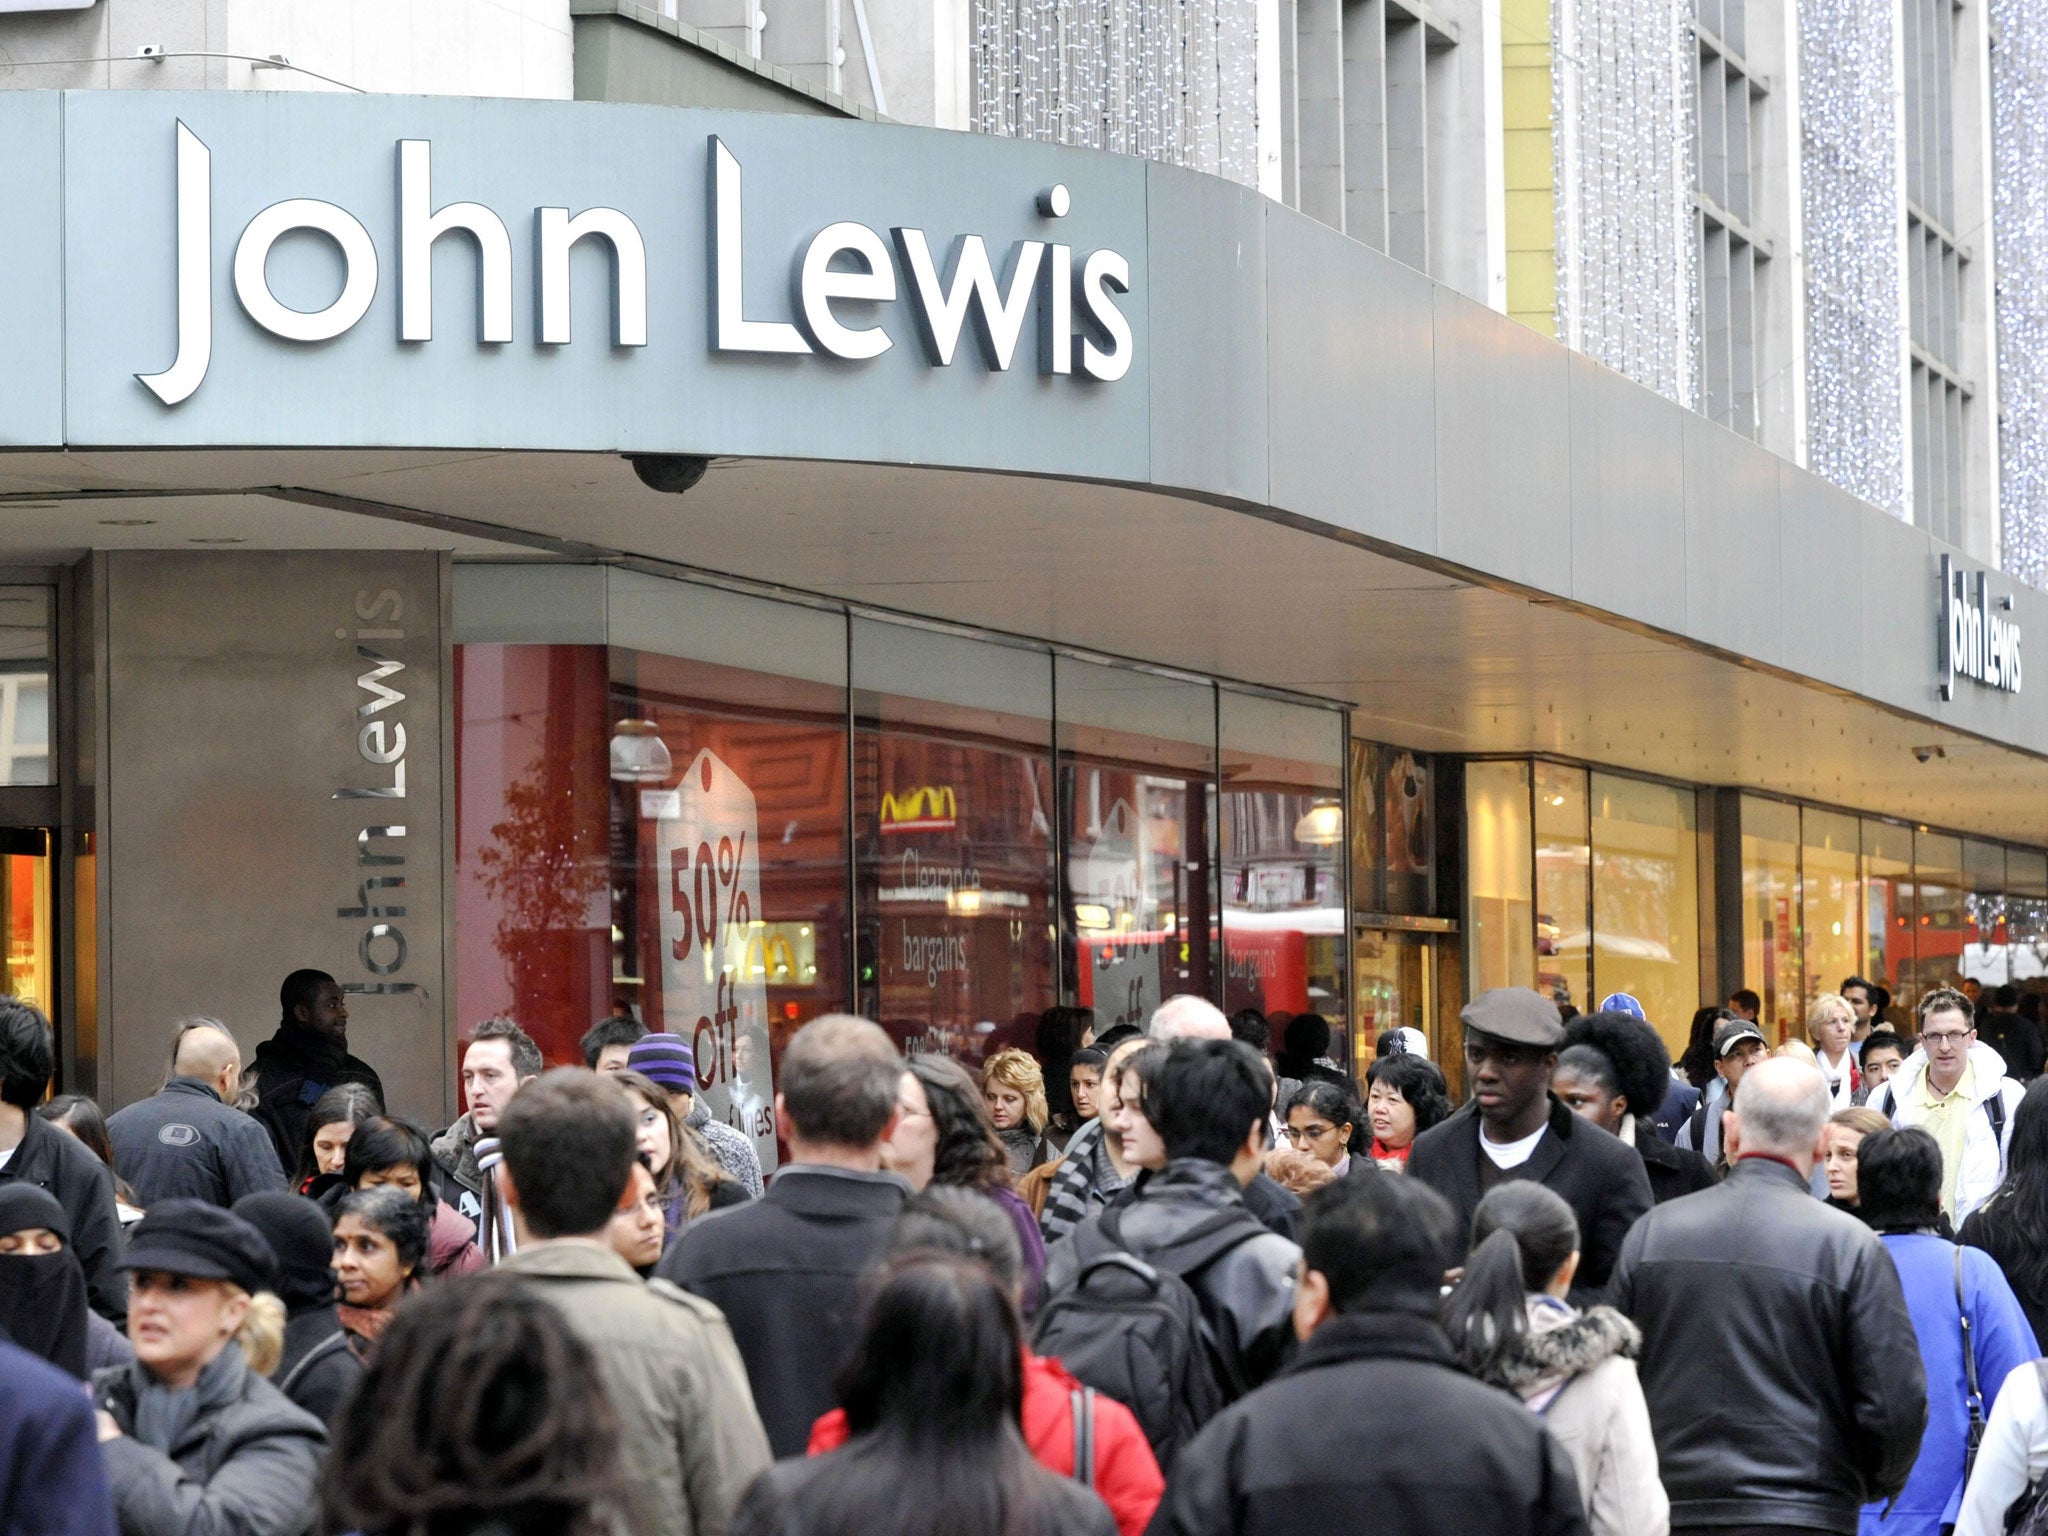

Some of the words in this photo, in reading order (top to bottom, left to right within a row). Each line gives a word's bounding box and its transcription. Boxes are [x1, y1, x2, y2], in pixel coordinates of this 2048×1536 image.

[133, 116, 648, 406] John
[707, 134, 1134, 382] Lewis
[1941, 554, 1982, 701] John
[1977, 571, 2022, 694] Lewis
[332, 588, 407, 799] Lewis
[337, 825, 431, 1008] John
[670, 830, 751, 961] 50%
[902, 847, 981, 901] Clearance
[902, 919, 967, 989] bargains
[1228, 932, 1277, 993] bargains
[693, 967, 738, 1092] off
